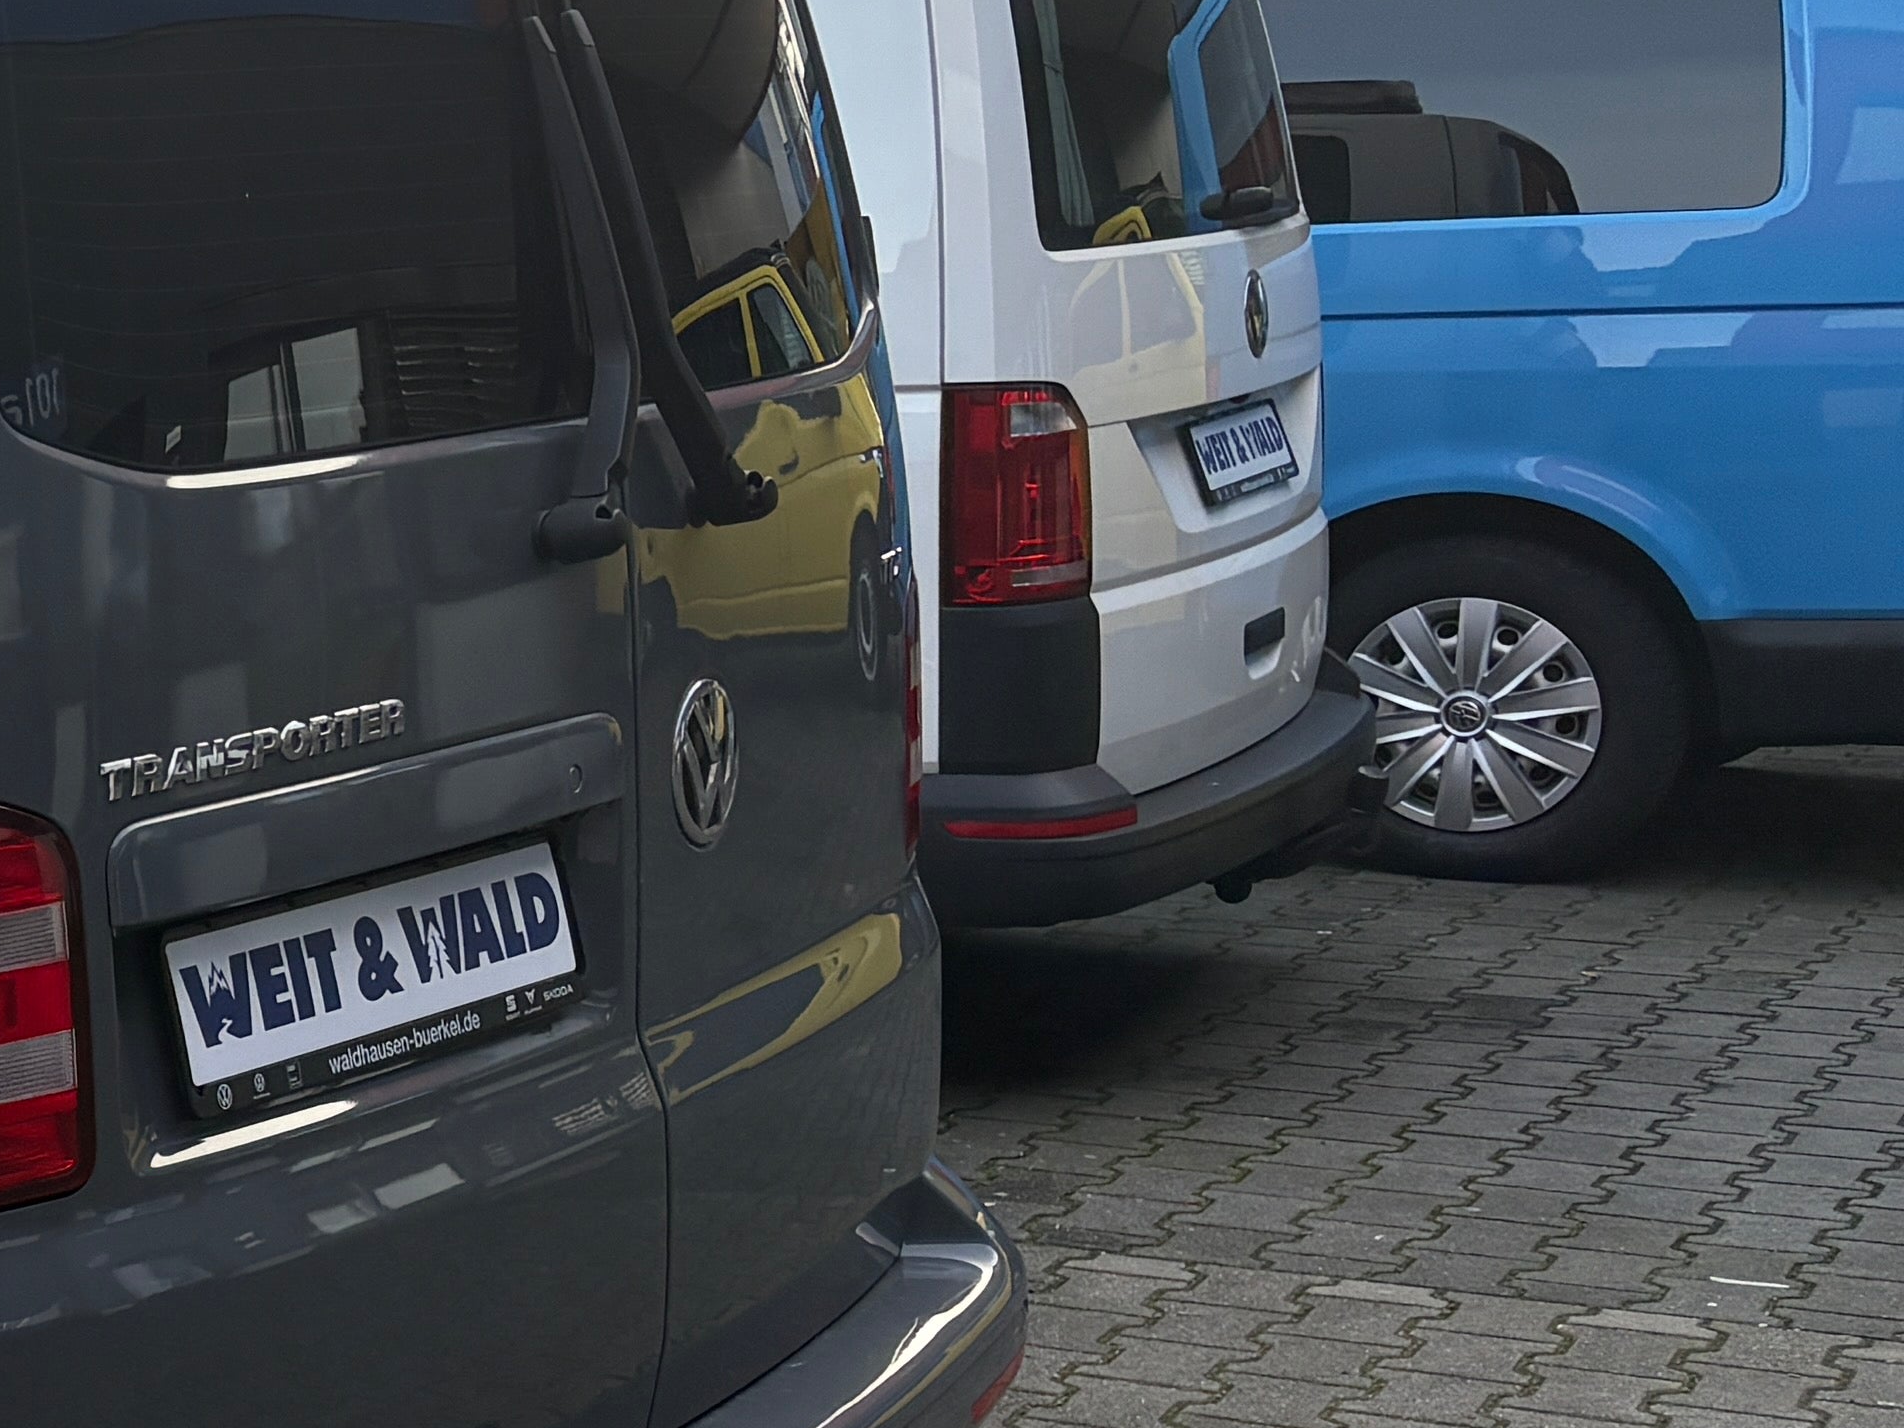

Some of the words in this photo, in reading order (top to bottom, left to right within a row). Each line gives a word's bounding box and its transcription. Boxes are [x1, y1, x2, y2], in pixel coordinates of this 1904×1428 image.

[100, 699, 406, 801] TRANSPORTER
[178, 928, 344, 1048] WEIT
[352, 915, 404, 1000] &
[397, 872, 560, 983] WALD
[329, 1010, 481, 1075] waldhausen-buerkel.de
